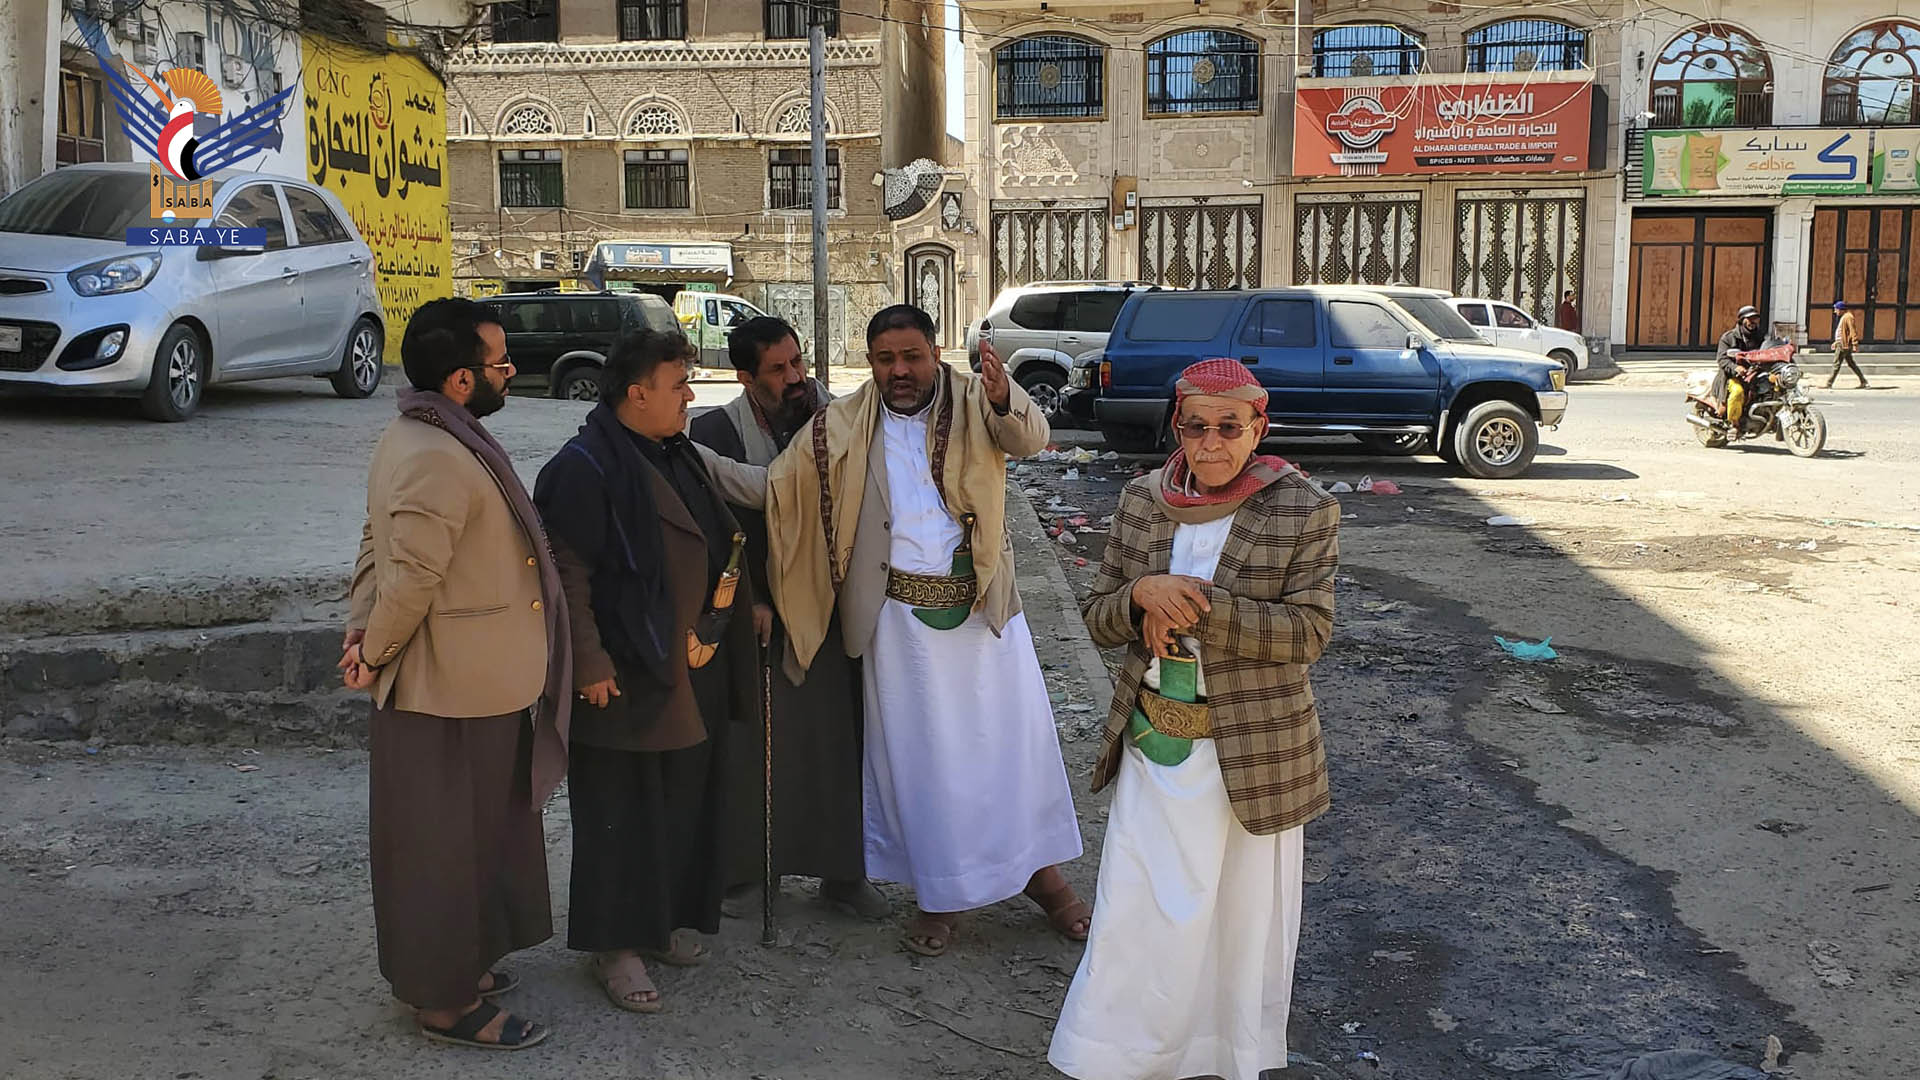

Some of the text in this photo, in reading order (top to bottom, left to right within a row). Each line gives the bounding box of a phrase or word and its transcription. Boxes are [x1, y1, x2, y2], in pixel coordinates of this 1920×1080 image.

[317, 66, 351, 98] CNC
[404, 85, 436, 115] محمد
[1438, 93, 1534, 120] الظفاري
[1476, 123, 1515, 138] العامة
[1518, 122, 1557, 138] للتجارة
[306, 95, 371, 189] للتجارة
[1412, 145, 1424, 153] AL
[1424, 144, 1457, 152] DHAFARI
[1458, 143, 1493, 152] GENERAL
[1495, 142, 1521, 151] TRADE
[1528, 141, 1558, 150] IMPORT
[1738, 135, 1807, 155] سابك
[374, 119, 442, 200] نشوان
[1429, 157, 1453, 165] SPICES
